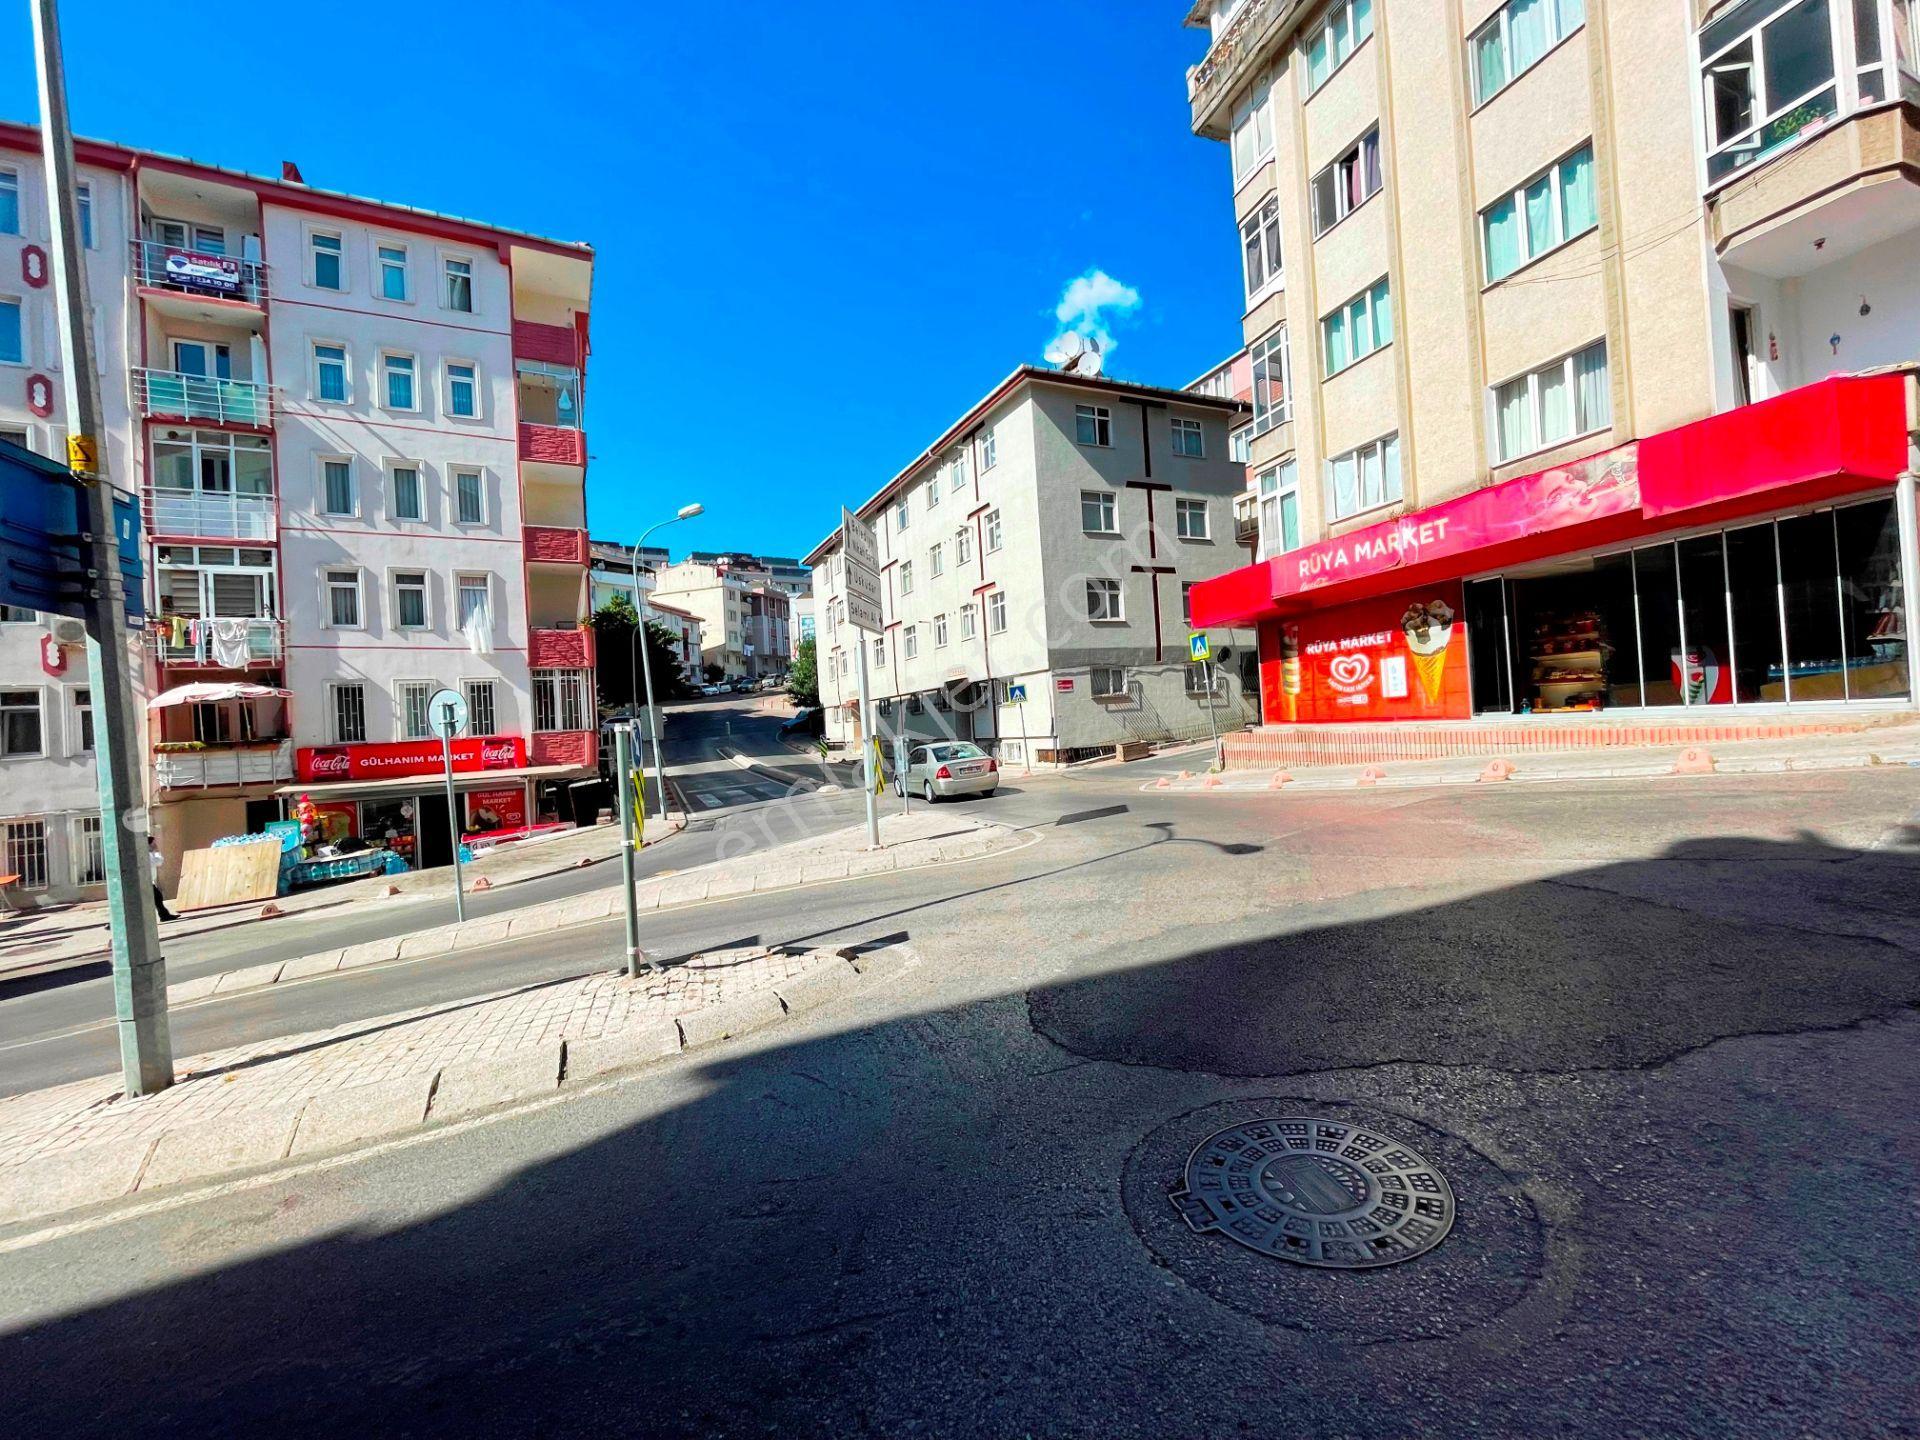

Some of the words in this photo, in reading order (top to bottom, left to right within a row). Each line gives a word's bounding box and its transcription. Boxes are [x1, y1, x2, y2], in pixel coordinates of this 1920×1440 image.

[1299, 549, 1349, 578] RÜYA
[1355, 518, 1449, 562] MARKET
[1306, 640, 1338, 655] RÜYA
[1341, 630, 1393, 650] MARKET
[312, 755, 350, 771] Coca-Cola
[360, 756, 424, 767] GÜLHANIM
[484, 746, 515, 760] Coca-Cola
[482, 797, 511, 805] MARKET
